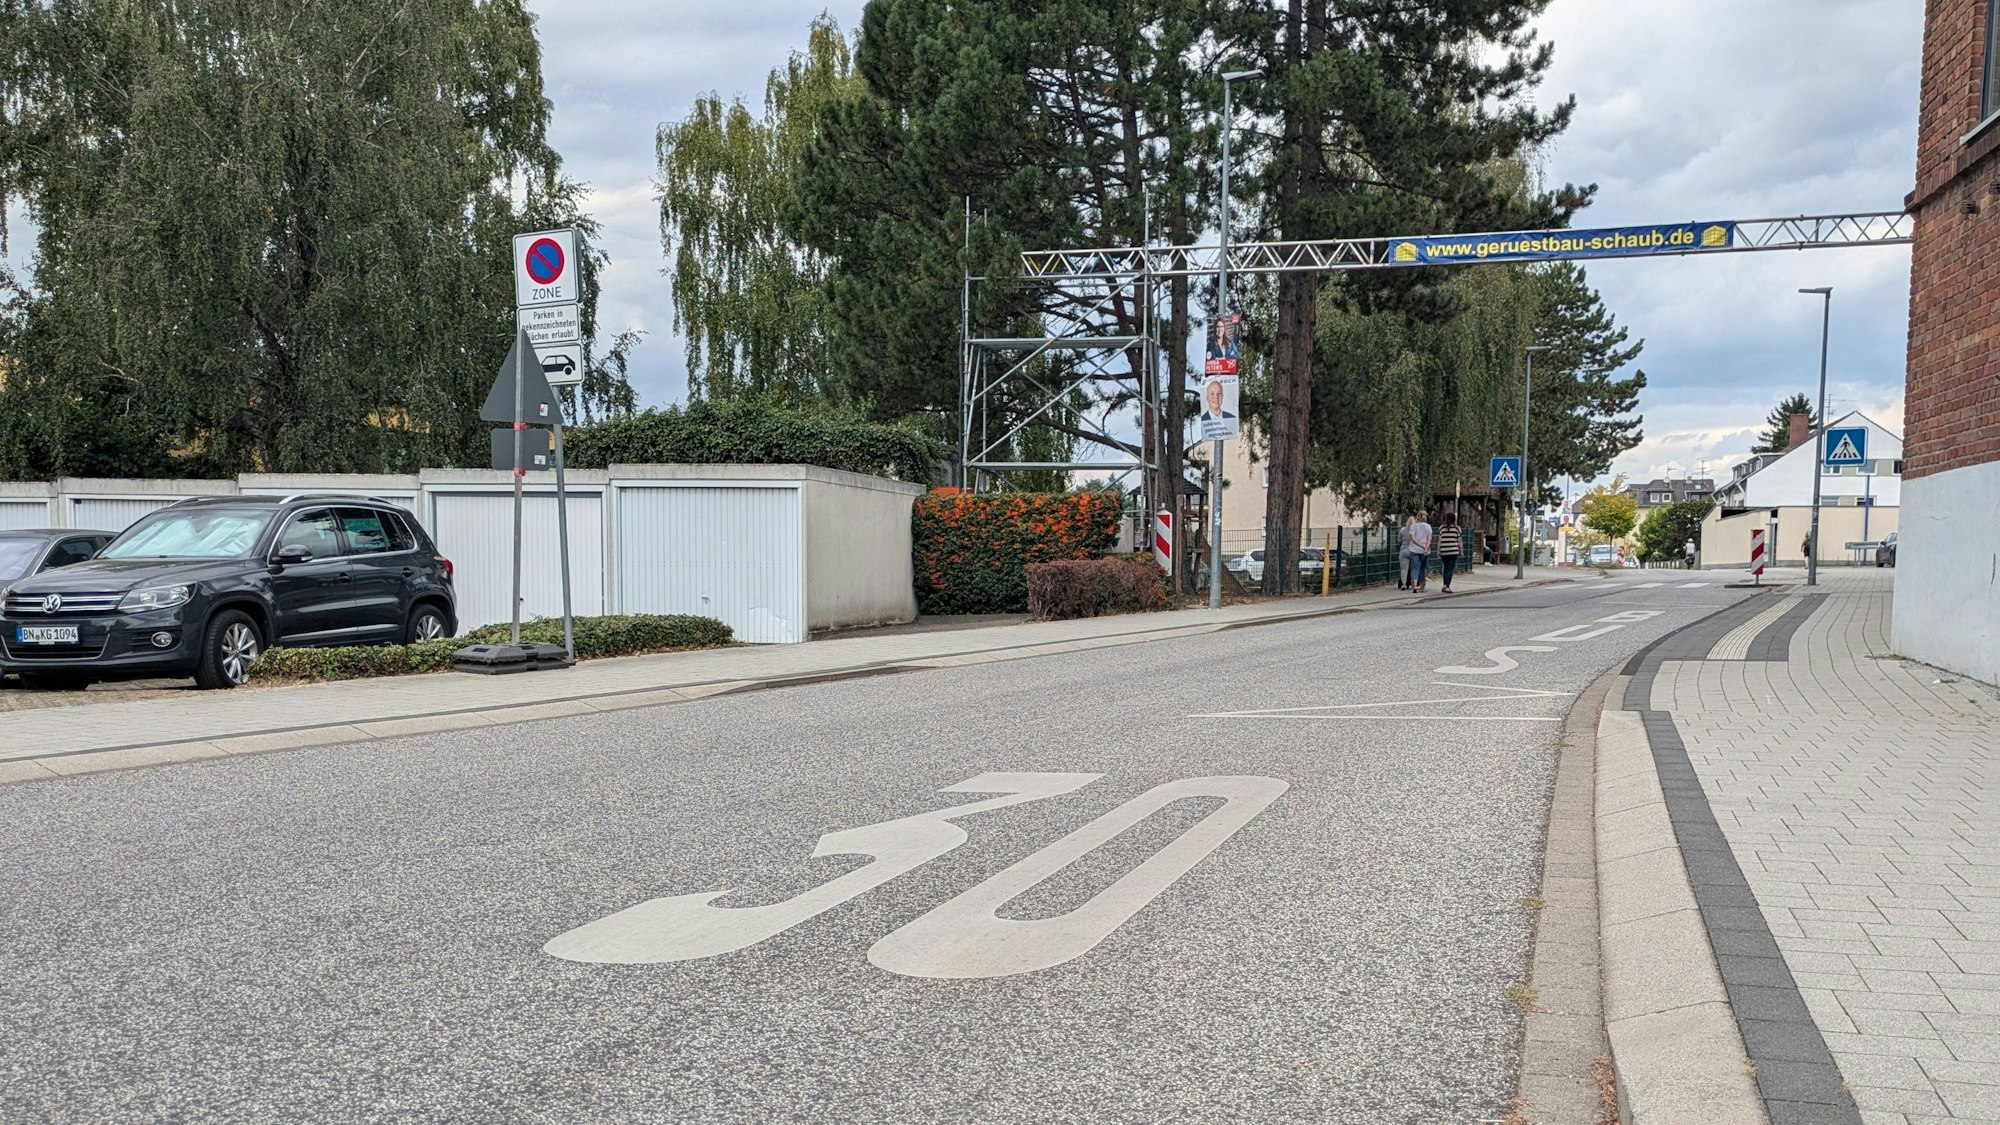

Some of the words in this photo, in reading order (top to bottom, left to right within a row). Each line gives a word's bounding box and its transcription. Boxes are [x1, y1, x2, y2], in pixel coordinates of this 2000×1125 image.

[1426, 229, 1694, 258] www.geruestbau-schaub.de
[532, 286, 562, 300] ZONE
[533, 310, 555, 320] Parken
[557, 310, 563, 318] in
[529, 332, 549, 341] lächen
[552, 330, 574, 340] erlaubt
[23, 629, 35, 640] BN
[41, 629, 52, 640] KG
[54, 629, 77, 640] 1094
[1433, 610, 1667, 675] BUS
[543, 772, 1290, 979] 30
